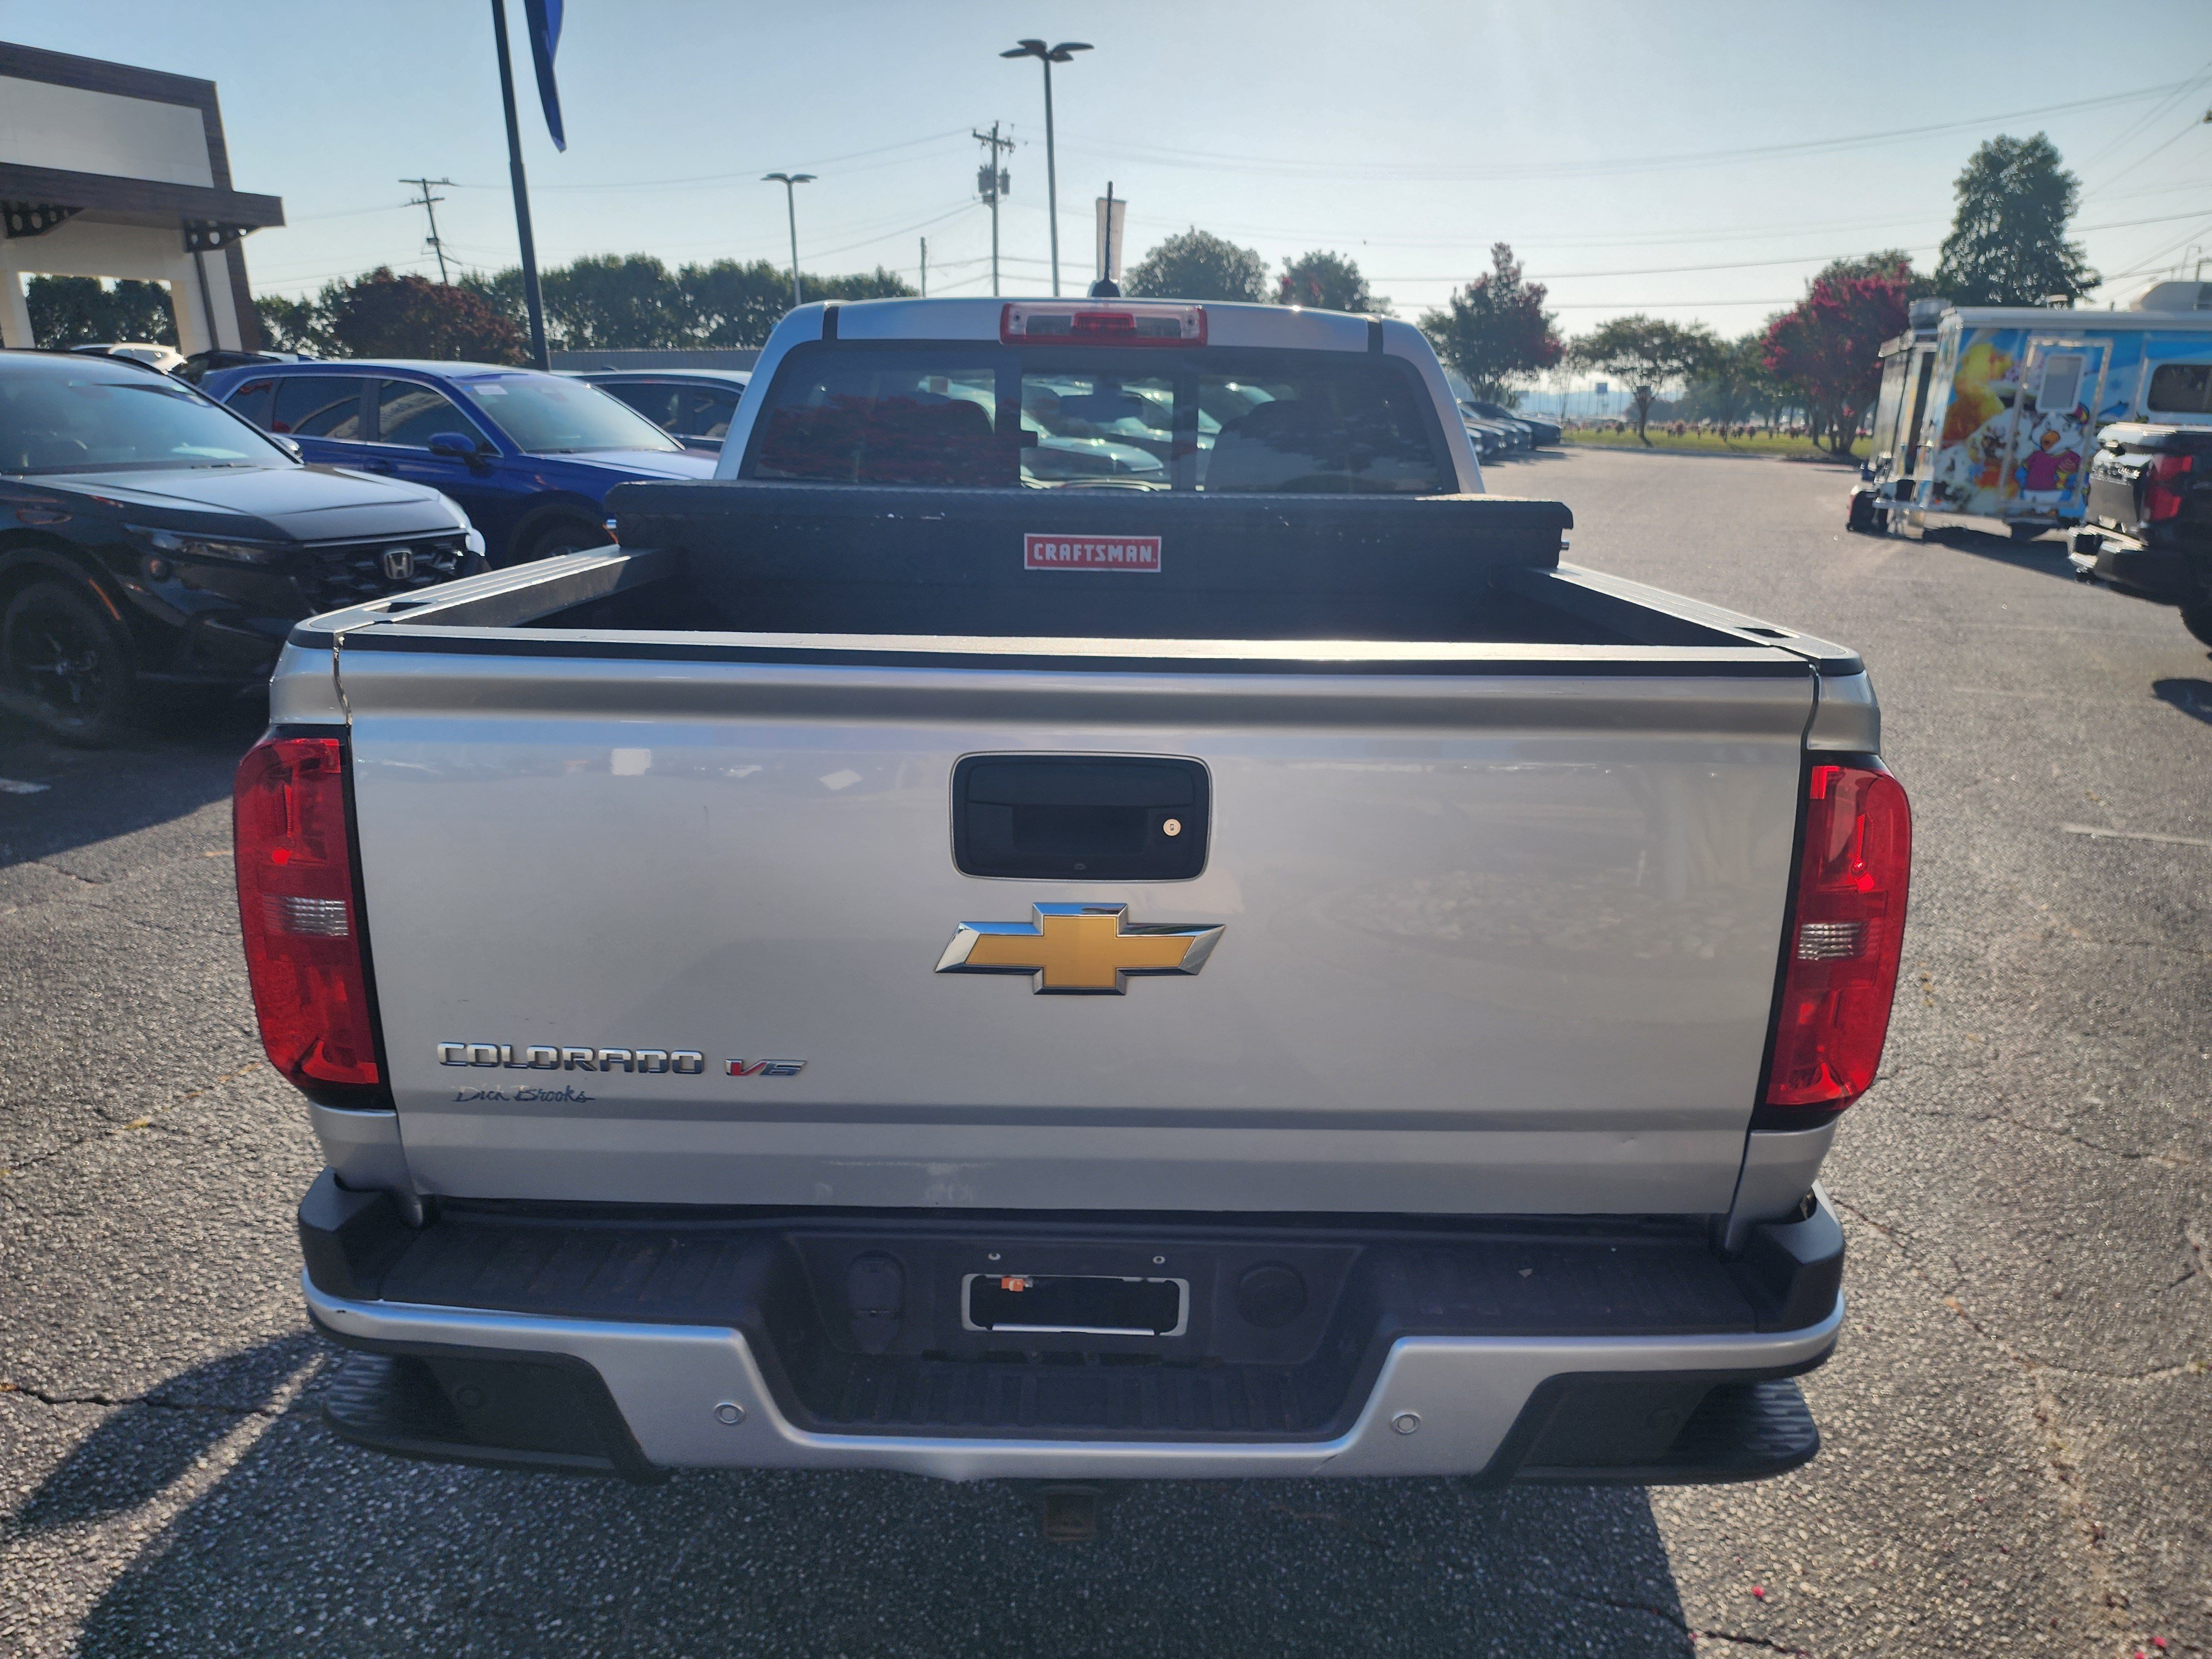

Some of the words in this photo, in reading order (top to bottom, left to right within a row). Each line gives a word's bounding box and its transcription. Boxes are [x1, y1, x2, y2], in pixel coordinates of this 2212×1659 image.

[1033, 542, 1152, 563] CRAFTSMAN
[437, 1041, 705, 1074] COLORADO
[724, 1058, 808, 1078] V6
[452, 1084, 510, 1103] Dick
[511, 1084, 596, 1103] Brooks
